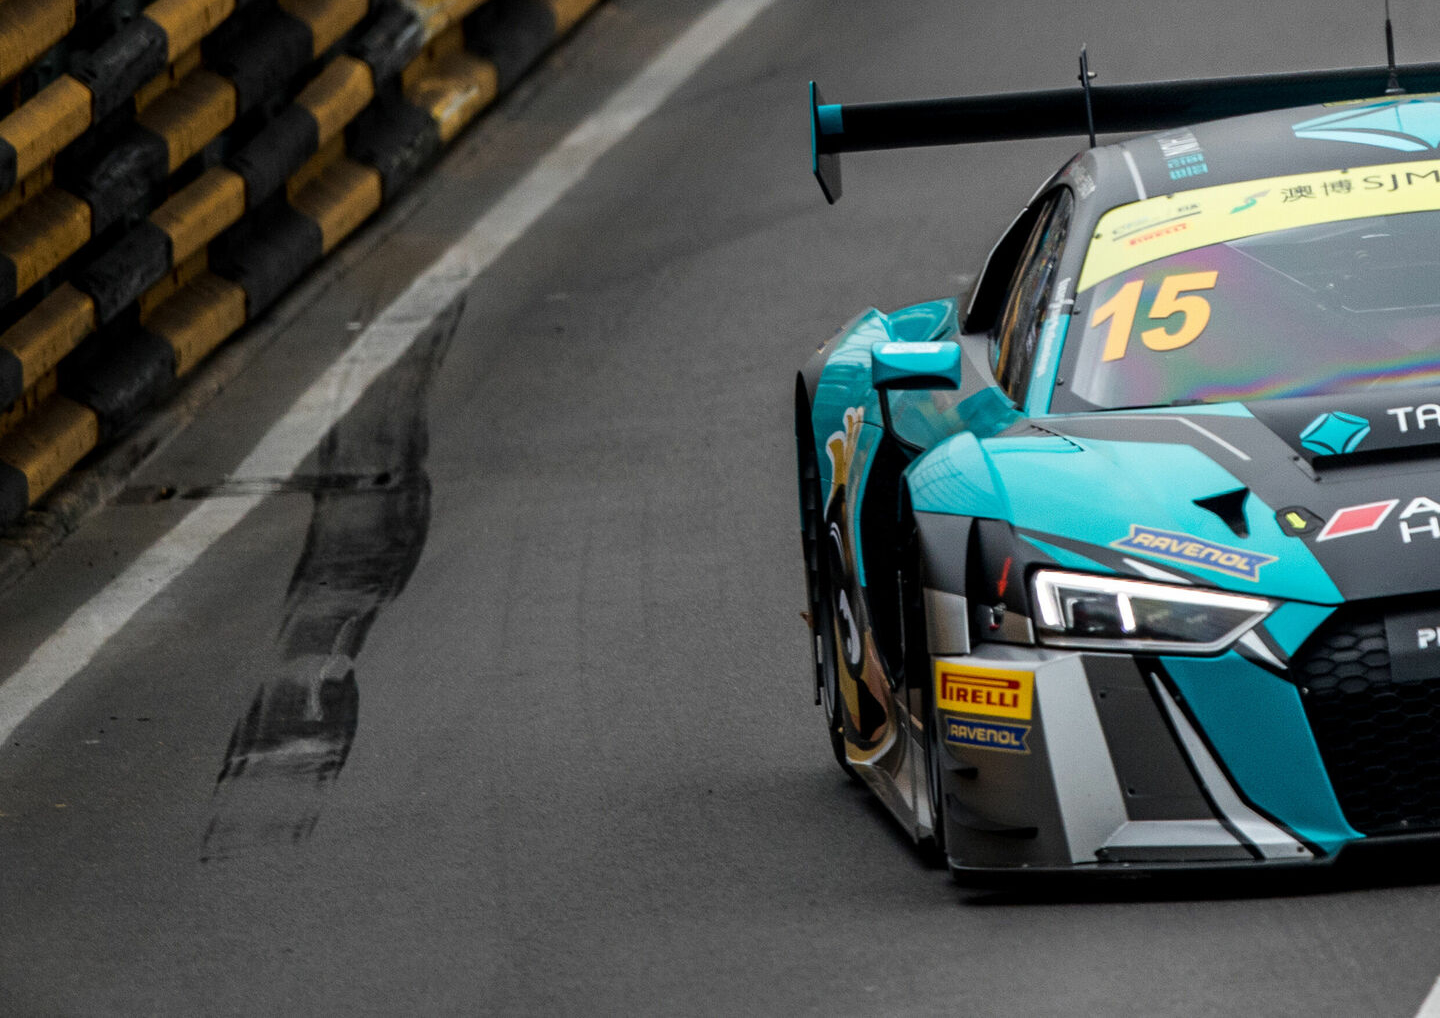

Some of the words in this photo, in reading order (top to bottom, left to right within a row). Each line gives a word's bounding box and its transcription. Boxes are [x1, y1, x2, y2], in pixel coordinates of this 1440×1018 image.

[1090, 270, 1219, 363] 15
[1131, 532, 1256, 572] RAVENOL
[941, 671, 1021, 709] PIRELLI
[949, 723, 1022, 747] RAVENOL
